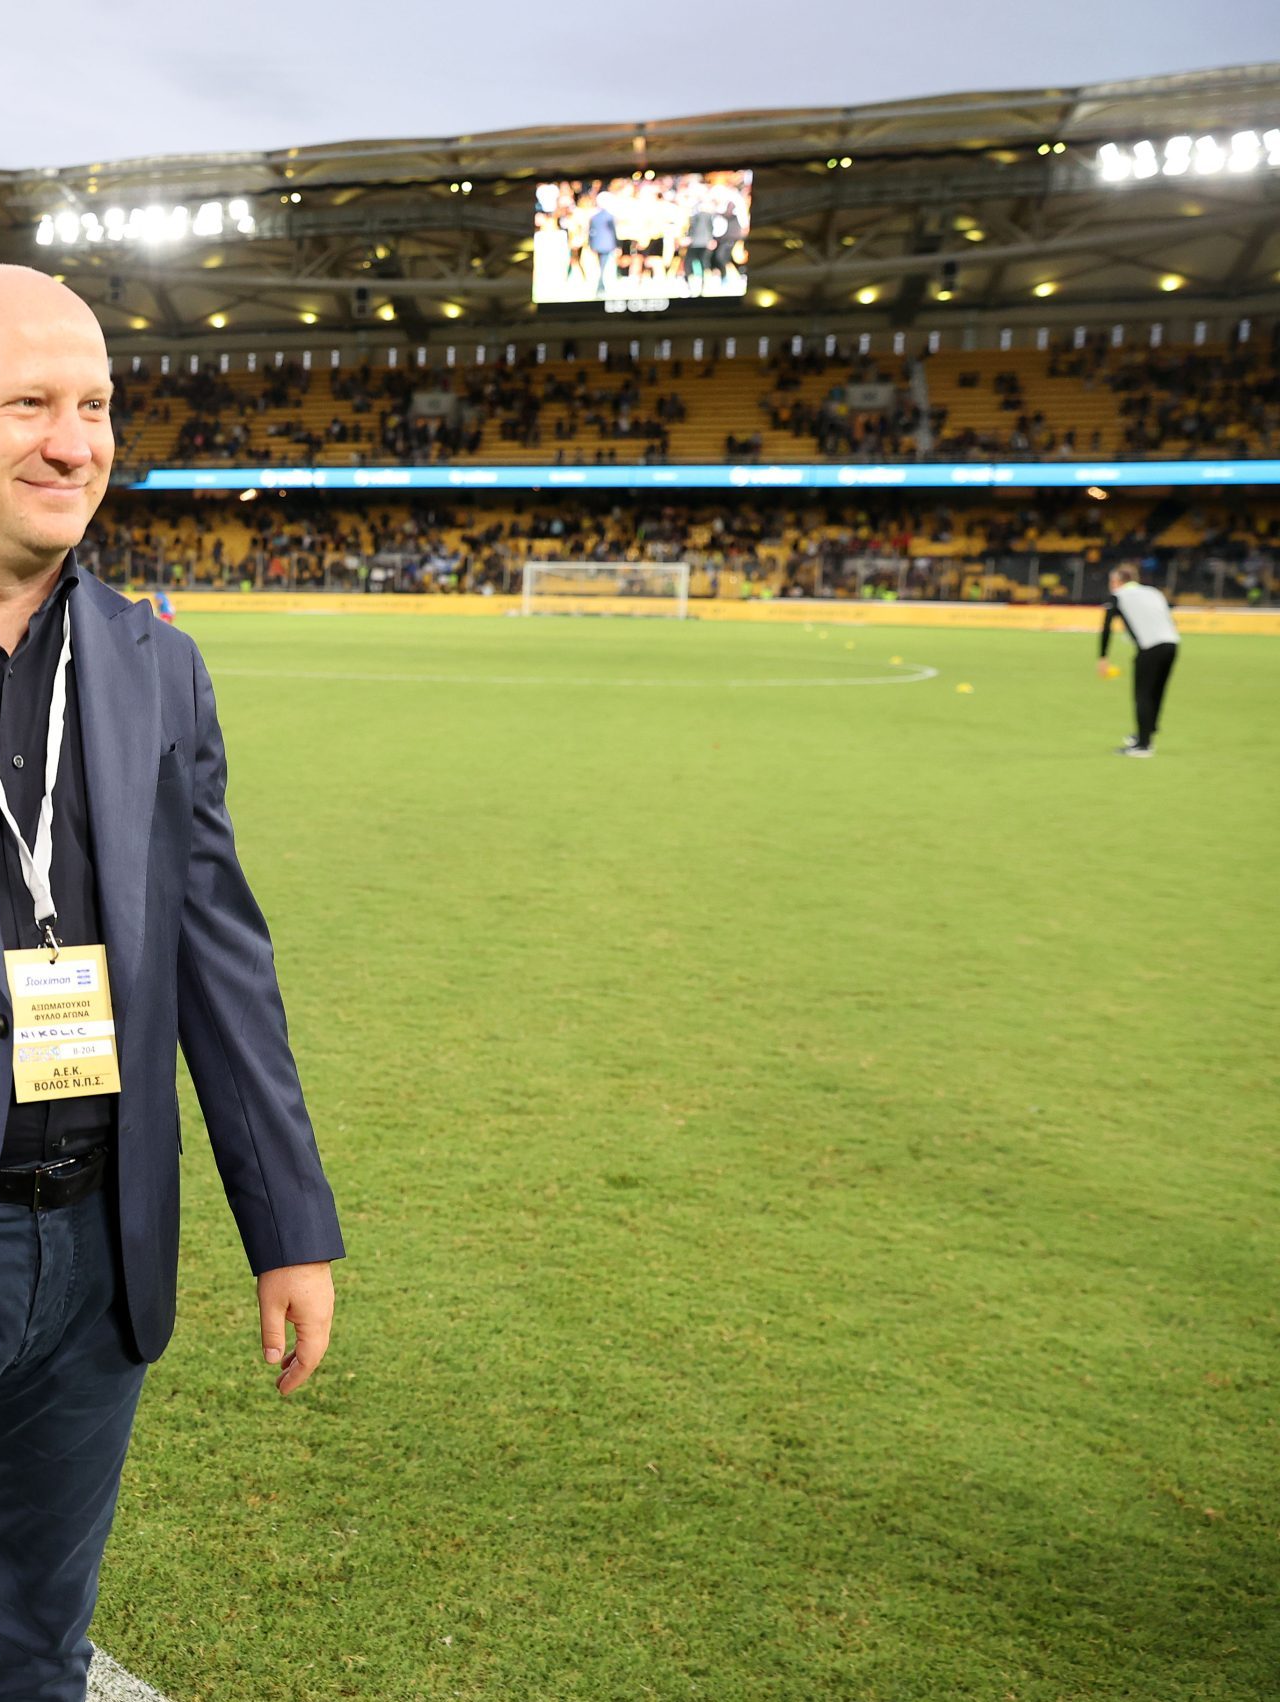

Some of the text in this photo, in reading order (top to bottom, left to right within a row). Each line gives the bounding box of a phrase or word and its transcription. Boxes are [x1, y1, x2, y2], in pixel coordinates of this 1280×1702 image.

[34, 1010, 90, 1021] ΦΥΛΛΟ ΑΓΩΝΑ
[21, 1027, 87, 1039] NIKOLIC
[53, 1066, 82, 1077] Α.Ε.Κ.
[34, 1076, 104, 1092] ΒΟΛΟΣ Ν.Π.Σ.
